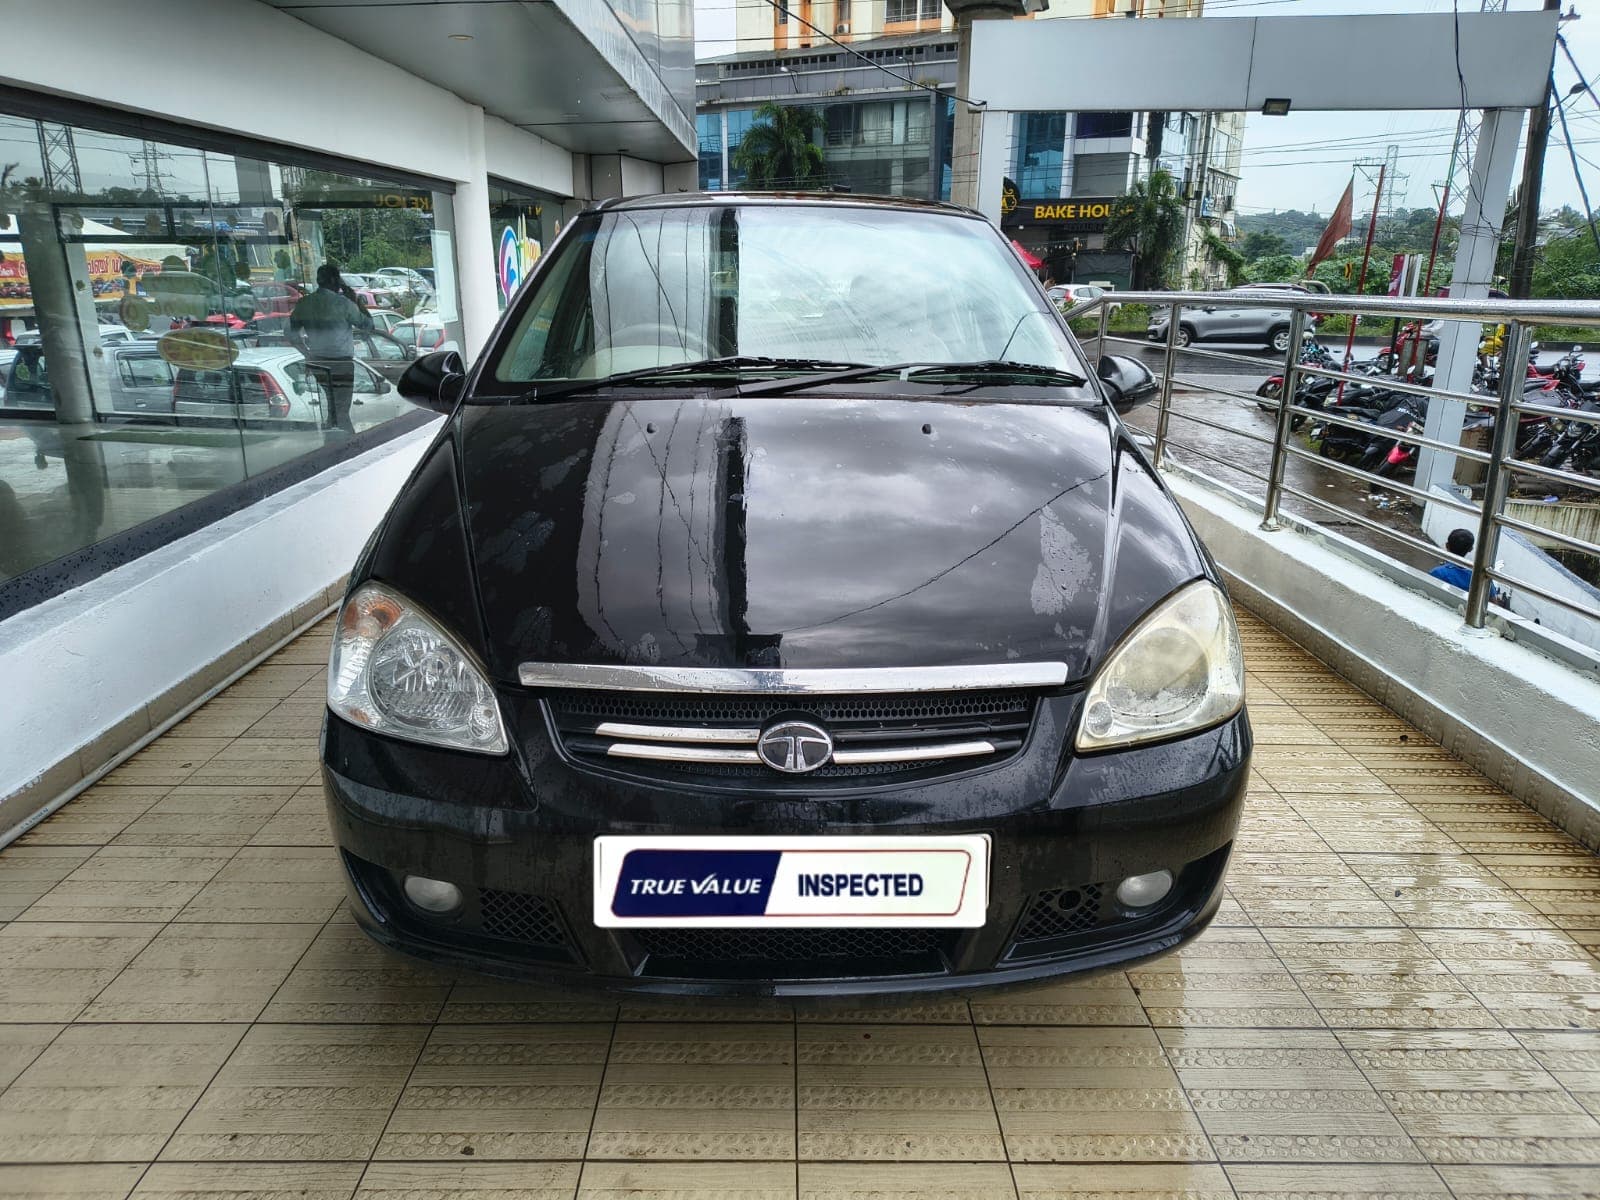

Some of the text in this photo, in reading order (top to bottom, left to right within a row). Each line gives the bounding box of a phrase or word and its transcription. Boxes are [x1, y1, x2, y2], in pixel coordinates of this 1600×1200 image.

[1034, 204, 1076, 219] BAKE
[630, 872, 762, 895] TRUE VALUE
[798, 873, 924, 897] INSPECTED
